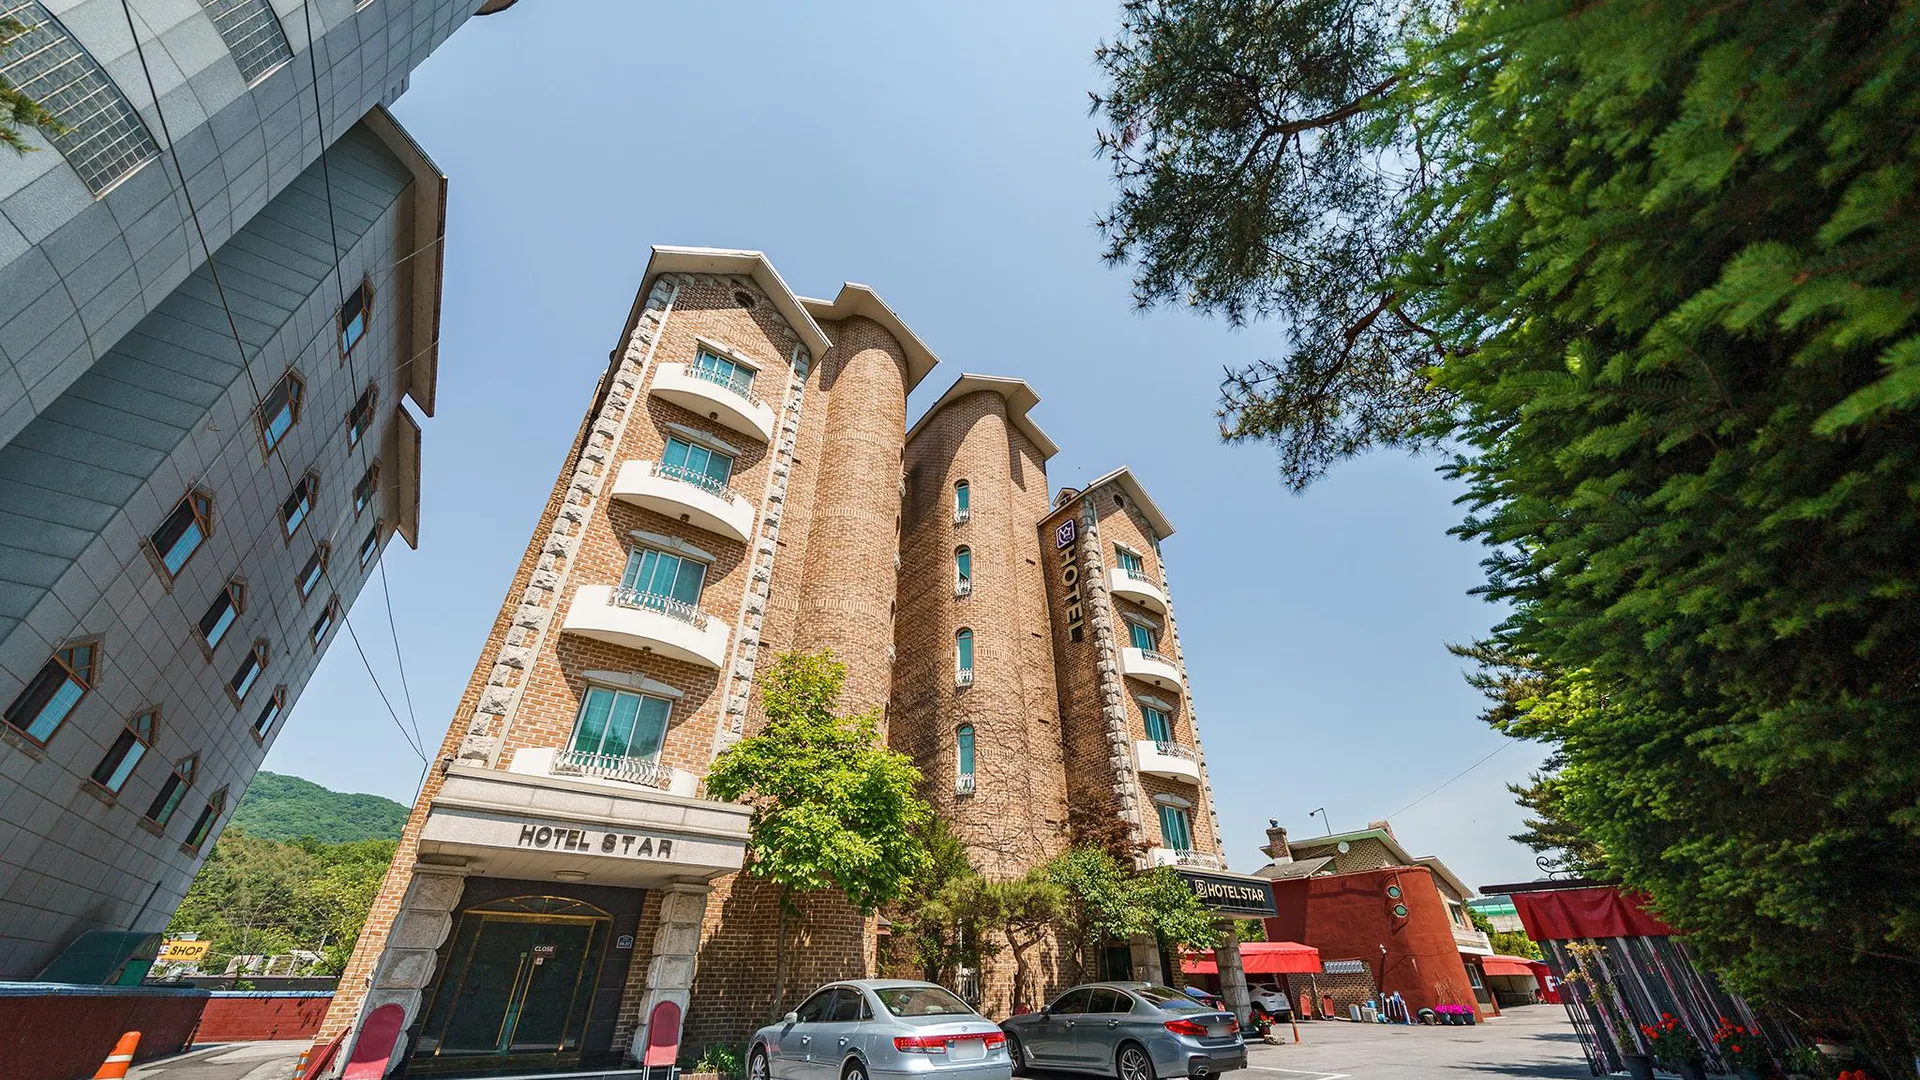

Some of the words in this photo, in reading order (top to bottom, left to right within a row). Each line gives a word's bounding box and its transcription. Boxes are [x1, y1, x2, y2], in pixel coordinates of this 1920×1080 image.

[1060, 544, 1084, 641] HOTEL
[518, 825, 590, 852] HOTEL
[601, 833, 673, 858] STAR
[1207, 883, 1241, 899] HOTEL
[1240, 887, 1266, 902] STAR
[170, 945, 203, 956] SHOP
